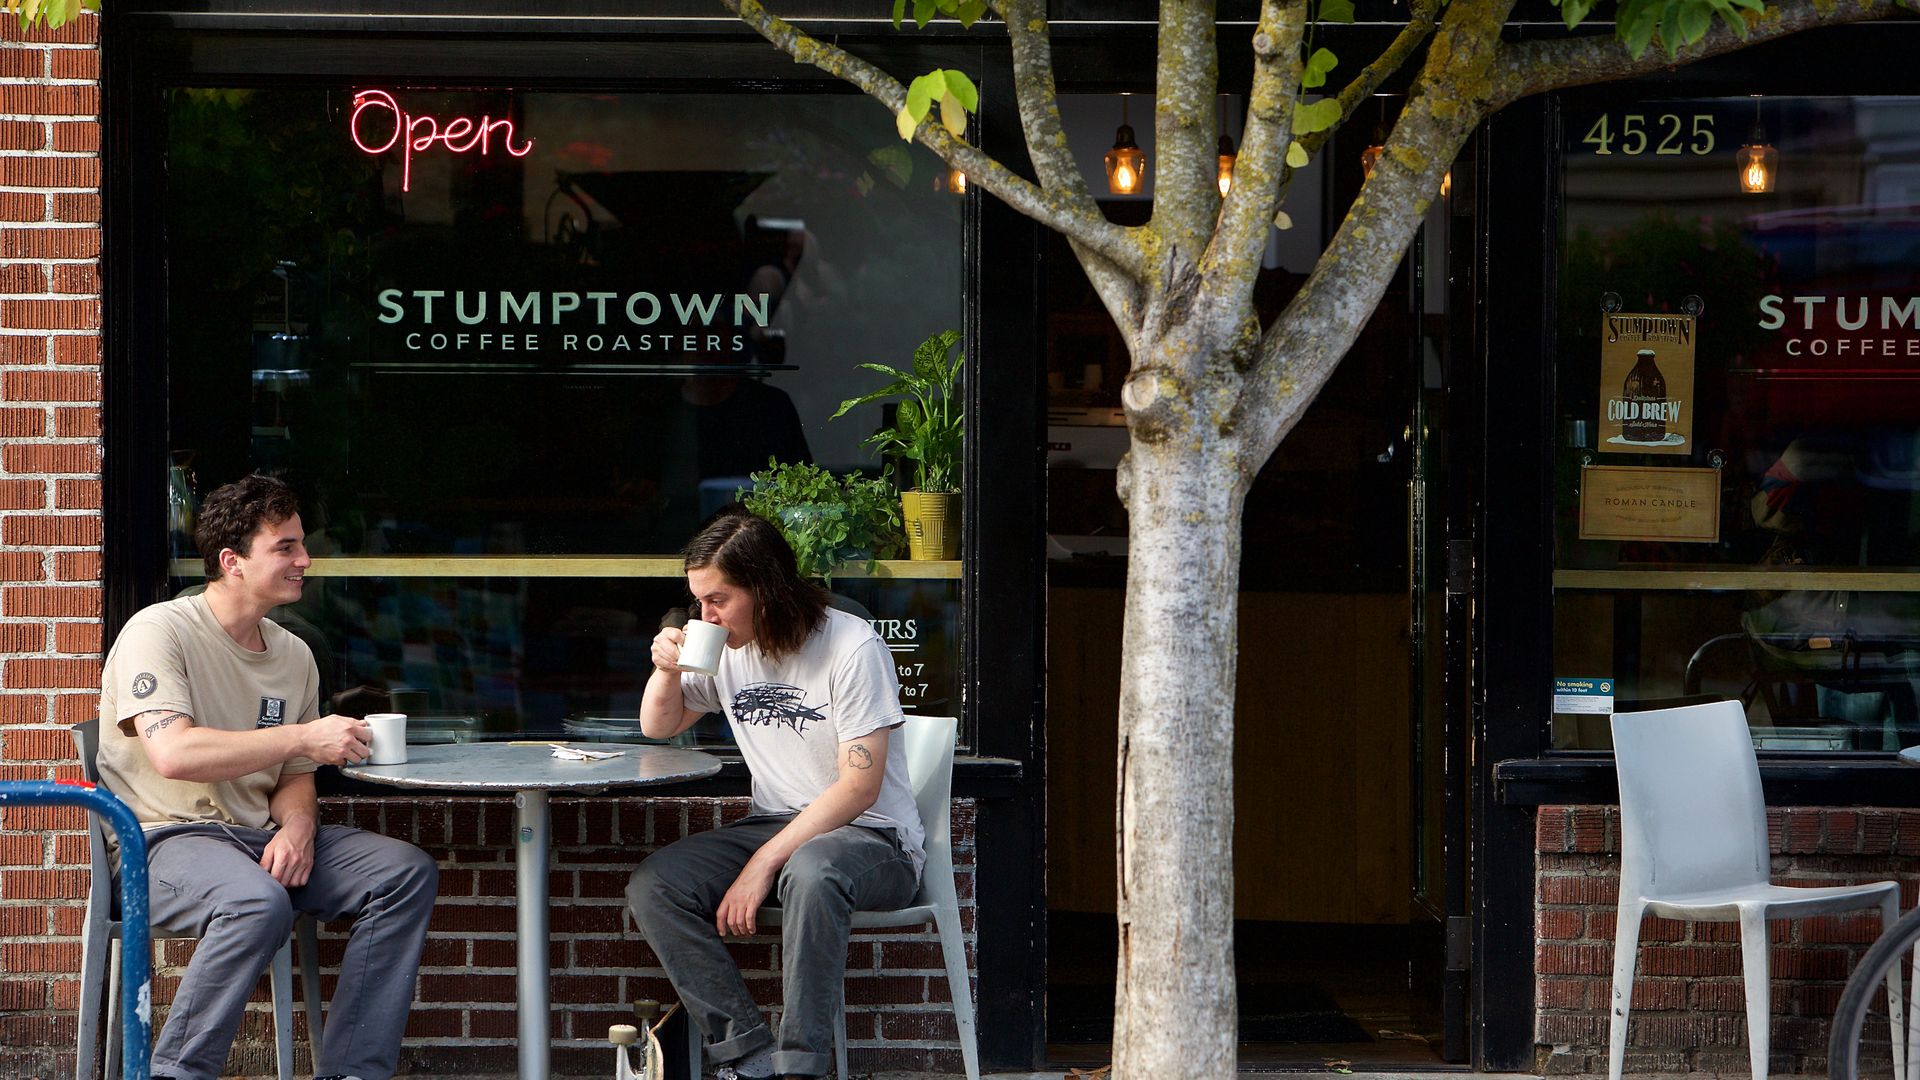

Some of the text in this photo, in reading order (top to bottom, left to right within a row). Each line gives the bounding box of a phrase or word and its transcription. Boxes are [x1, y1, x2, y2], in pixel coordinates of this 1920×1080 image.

[351, 89, 533, 192] Open
[1582, 113, 1715, 155] 4525
[377, 288, 770, 327] STUMPTOWN
[1758, 294, 1920, 331] STUM
[1607, 316, 1691, 345] STUMPTOWN
[406, 333, 744, 351] COFFEE ROASTERS
[1786, 338, 1920, 356] COFFEE
[1607, 399, 1682, 423] COLD BREW
[1605, 498, 1697, 508] ROMAN CANDLE
[867, 619, 917, 640] URS
[898, 663, 925, 677] to 7
[904, 686, 917, 697] to
[918, 683, 929, 698] 7
